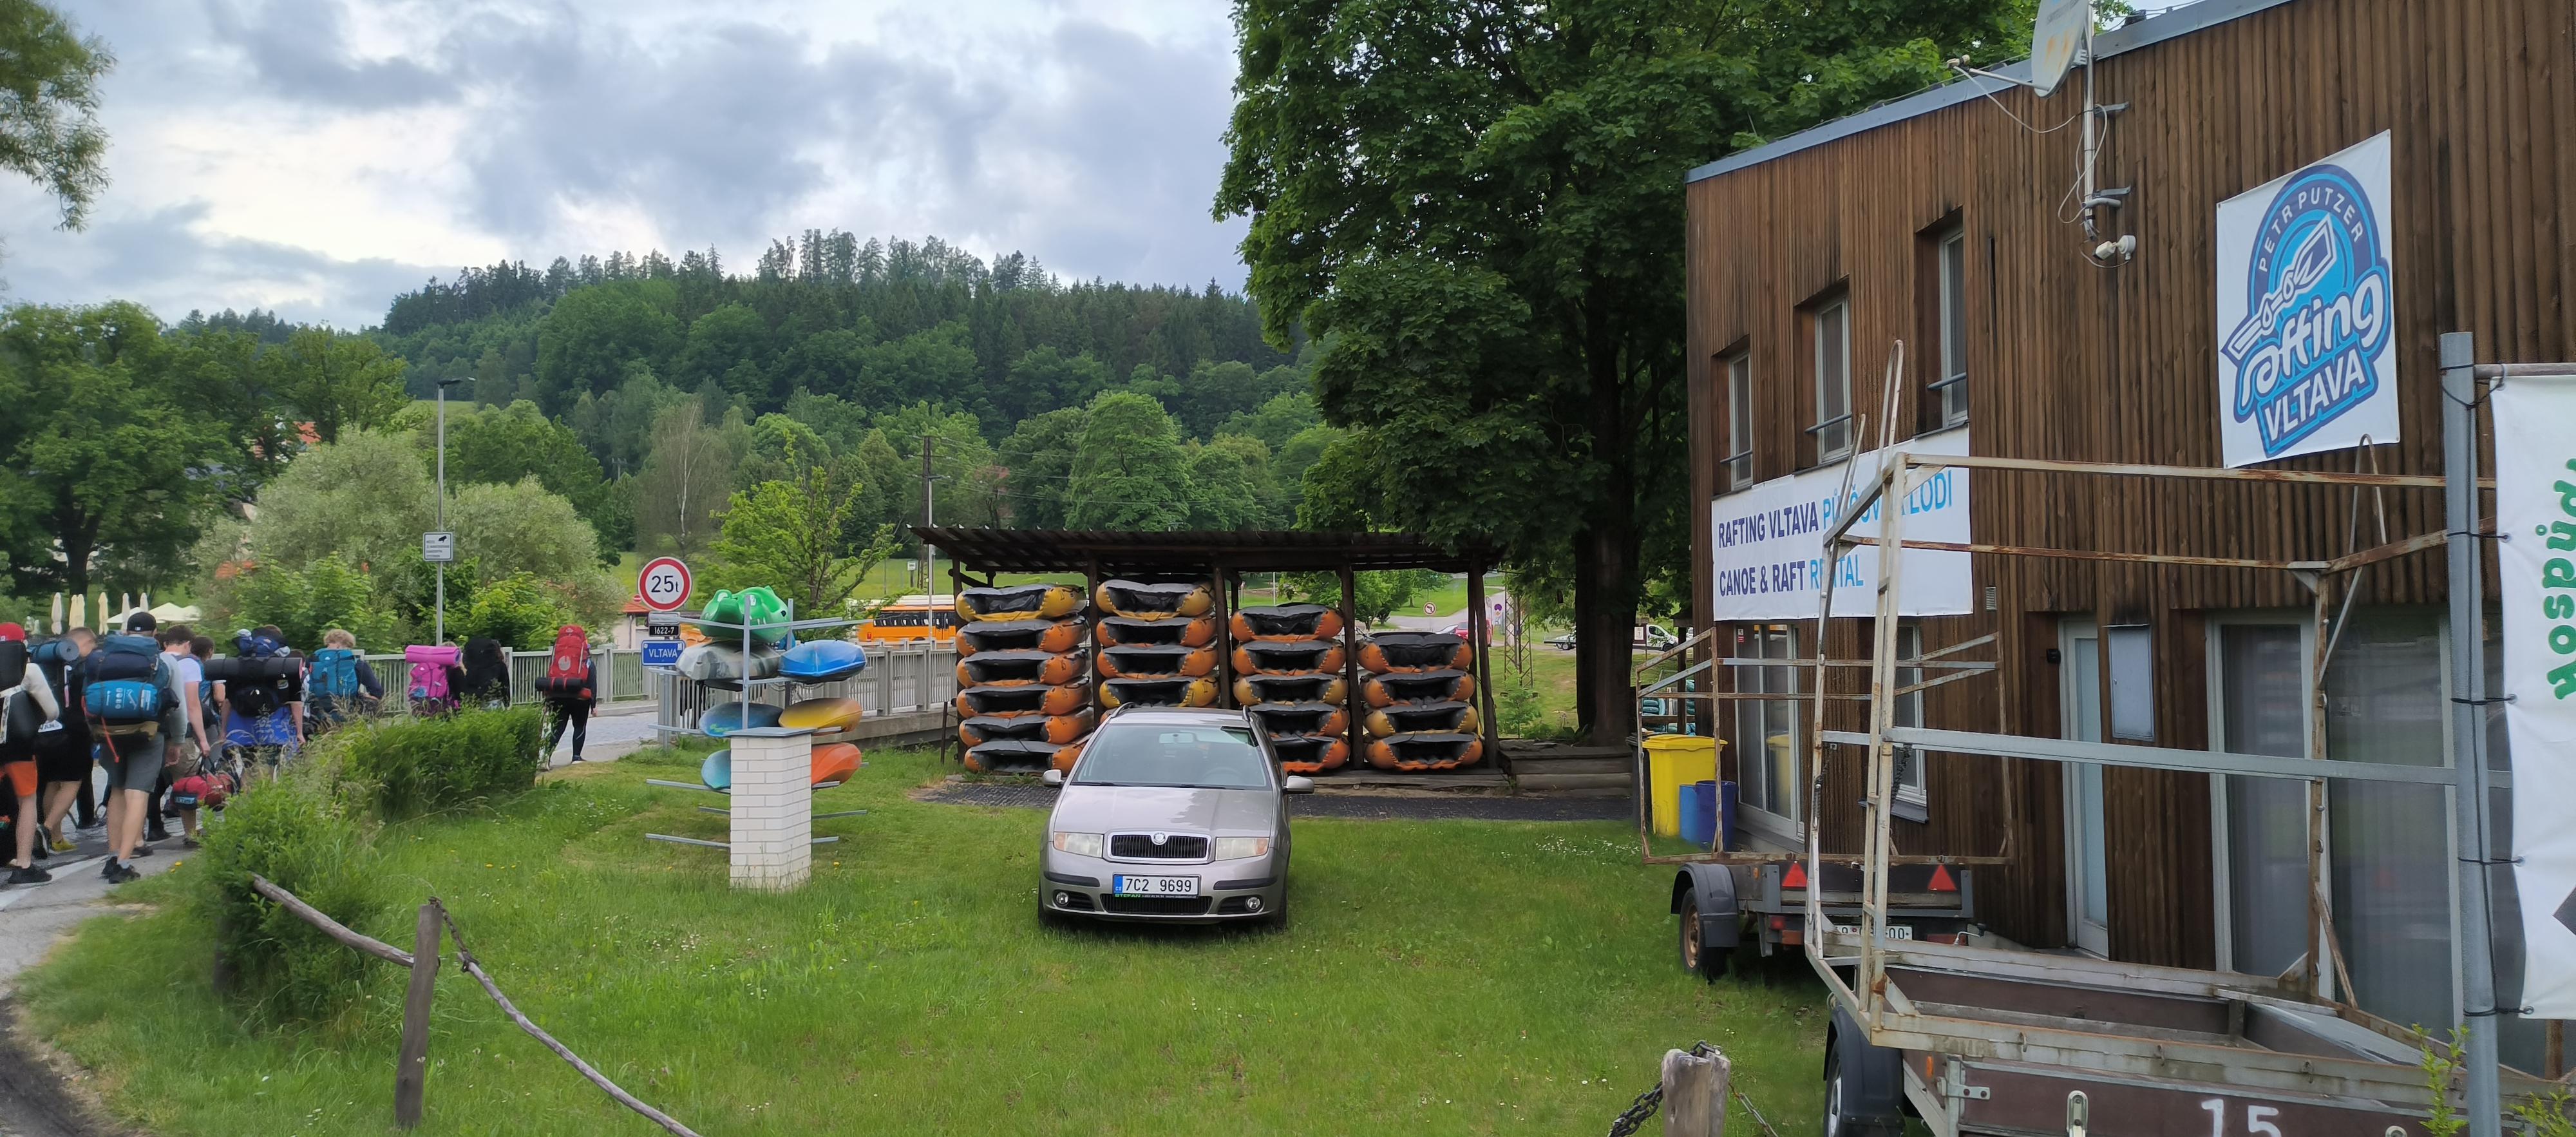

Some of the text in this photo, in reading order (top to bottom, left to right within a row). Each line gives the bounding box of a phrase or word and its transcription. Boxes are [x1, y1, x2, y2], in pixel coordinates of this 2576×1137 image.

[2259, 186, 2364, 272] PETR PUTZER
[2264, 347, 2365, 441] VLTAVA
[1718, 513, 1765, 548] RAFTING
[1768, 501, 1819, 539] VLTAVA
[1719, 554, 1864, 597] CANOE & RAFT RTAL
[654, 626, 676, 635] 1622-7
[649, 648, 678, 658] VLTAVA
[1126, 878, 1191, 892] 7C2 9699
[2201, 1098, 2282, 1137] 15
